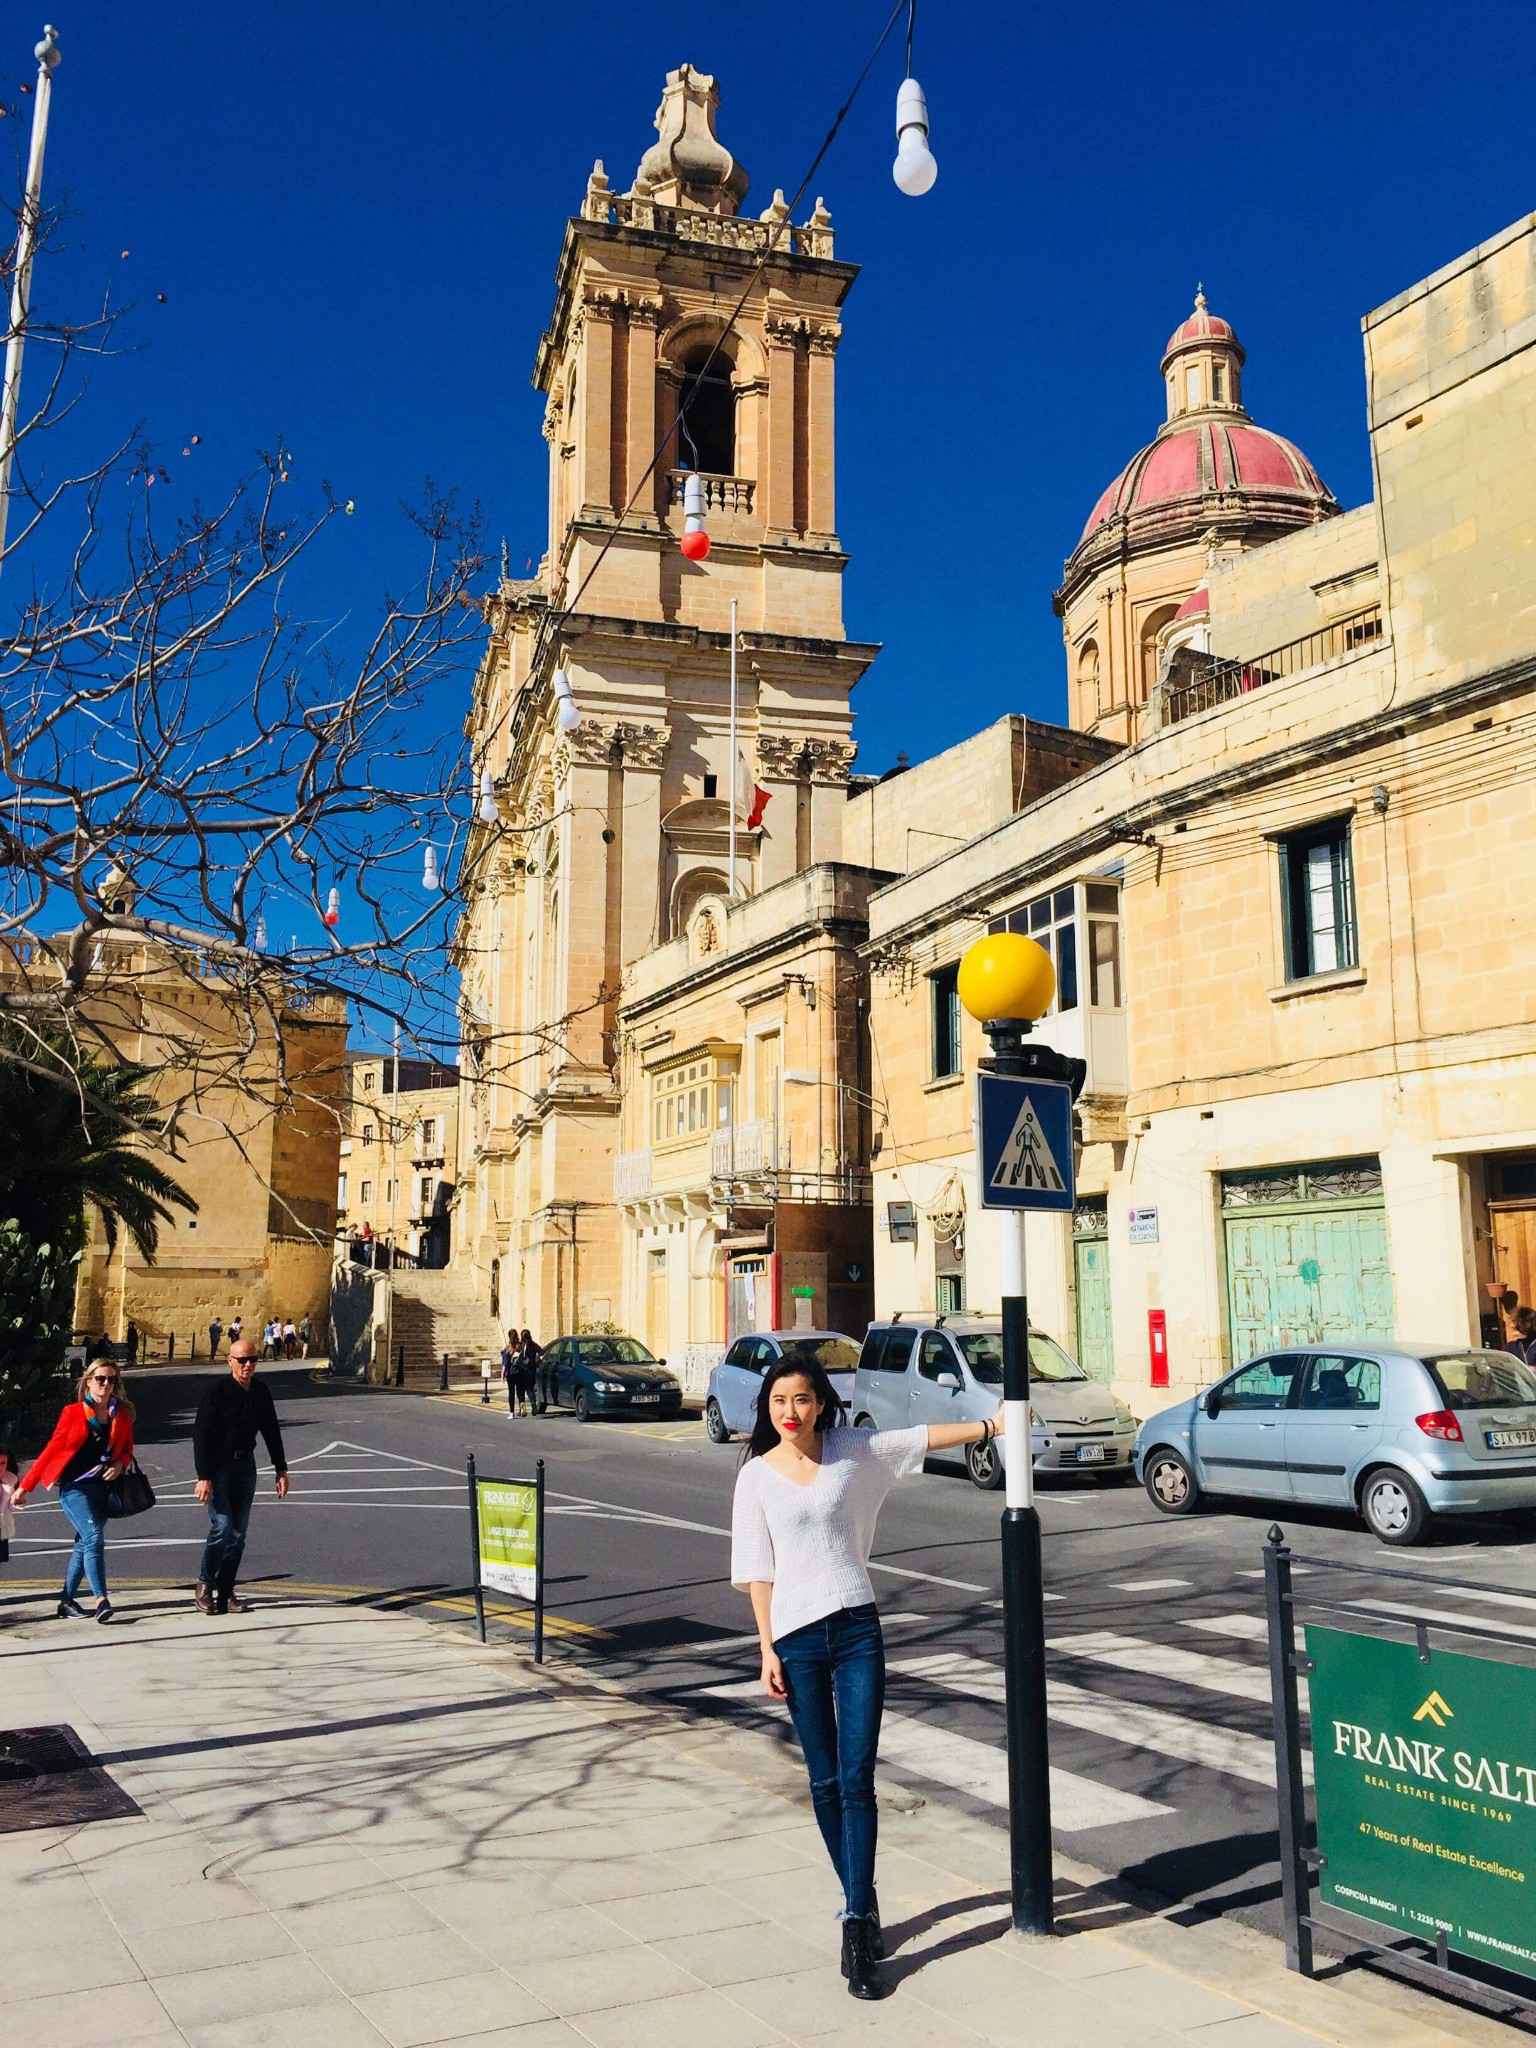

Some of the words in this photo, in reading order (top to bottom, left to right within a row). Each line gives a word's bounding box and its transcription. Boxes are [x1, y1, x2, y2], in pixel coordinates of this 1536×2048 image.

[1332, 1720, 1448, 1782] FRANK
[1454, 1752, 1536, 1807] SALT
[1364, 1774, 1391, 1790] REAL
[1396, 1784, 1436, 1803] ESTATE
[1441, 1795, 1477, 1813] SINCE
[1483, 1807, 1512, 1823] 1969
[1359, 1822, 1372, 1834] 47
[1373, 1826, 1399, 1843] Years
[1400, 1835, 1411, 1847] of
[1412, 1838, 1433, 1855] Real
[1436, 1844, 1467, 1865] Estate
[1469, 1855, 1525, 1882] Excellence
[1334, 1884, 1369, 1904] COSPICUA
[1369, 1896, 1397, 1913] BRANCH
